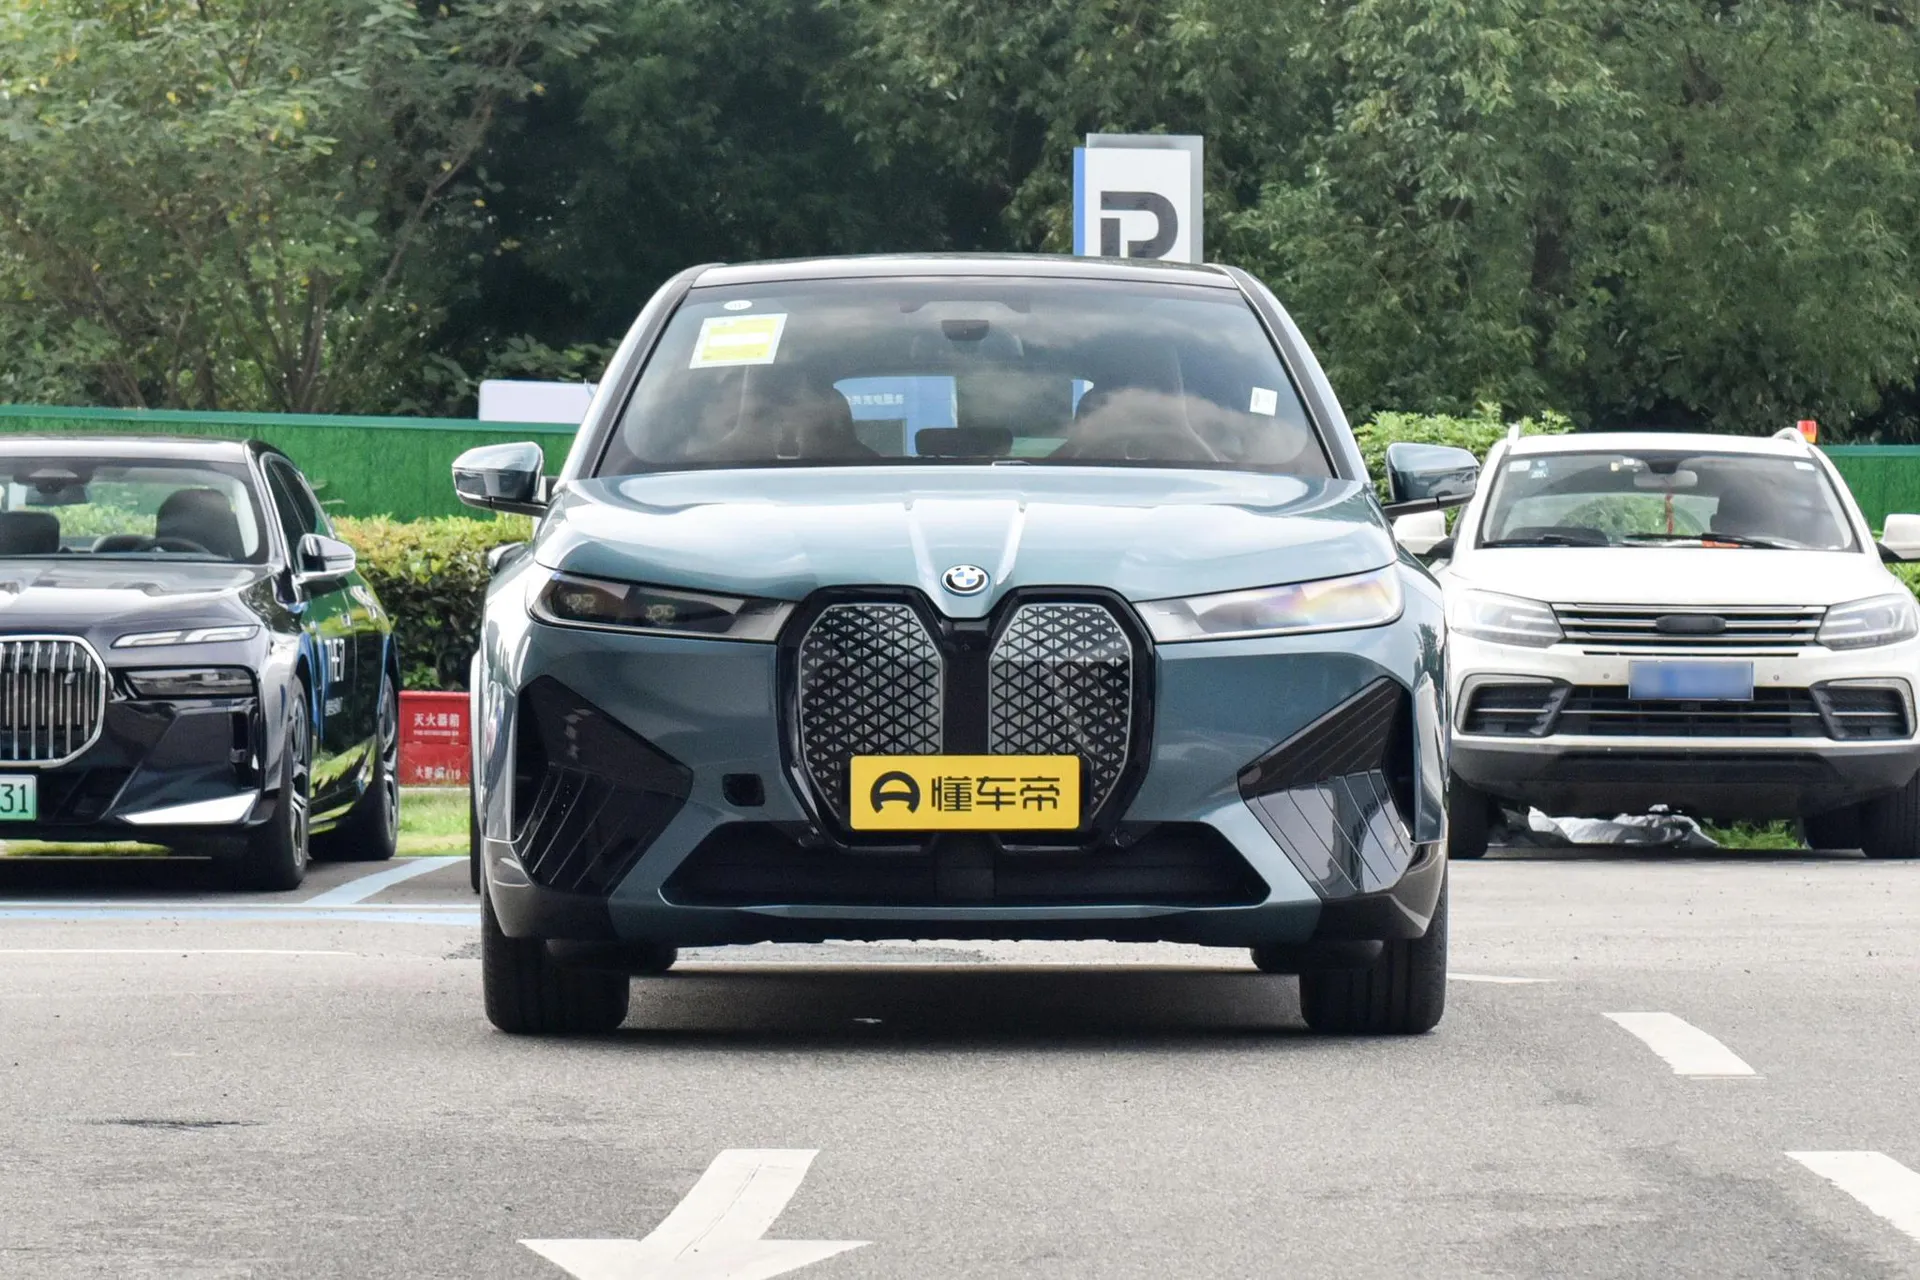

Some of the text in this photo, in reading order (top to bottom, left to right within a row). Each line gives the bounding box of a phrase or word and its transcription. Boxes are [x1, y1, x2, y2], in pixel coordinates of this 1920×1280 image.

[1101, 191, 1178, 258] P
[413, 712, 460, 728] 灭火器箱
[0, 783, 28, 813] 31
[931, 776, 1060, 811] 懂车帝
